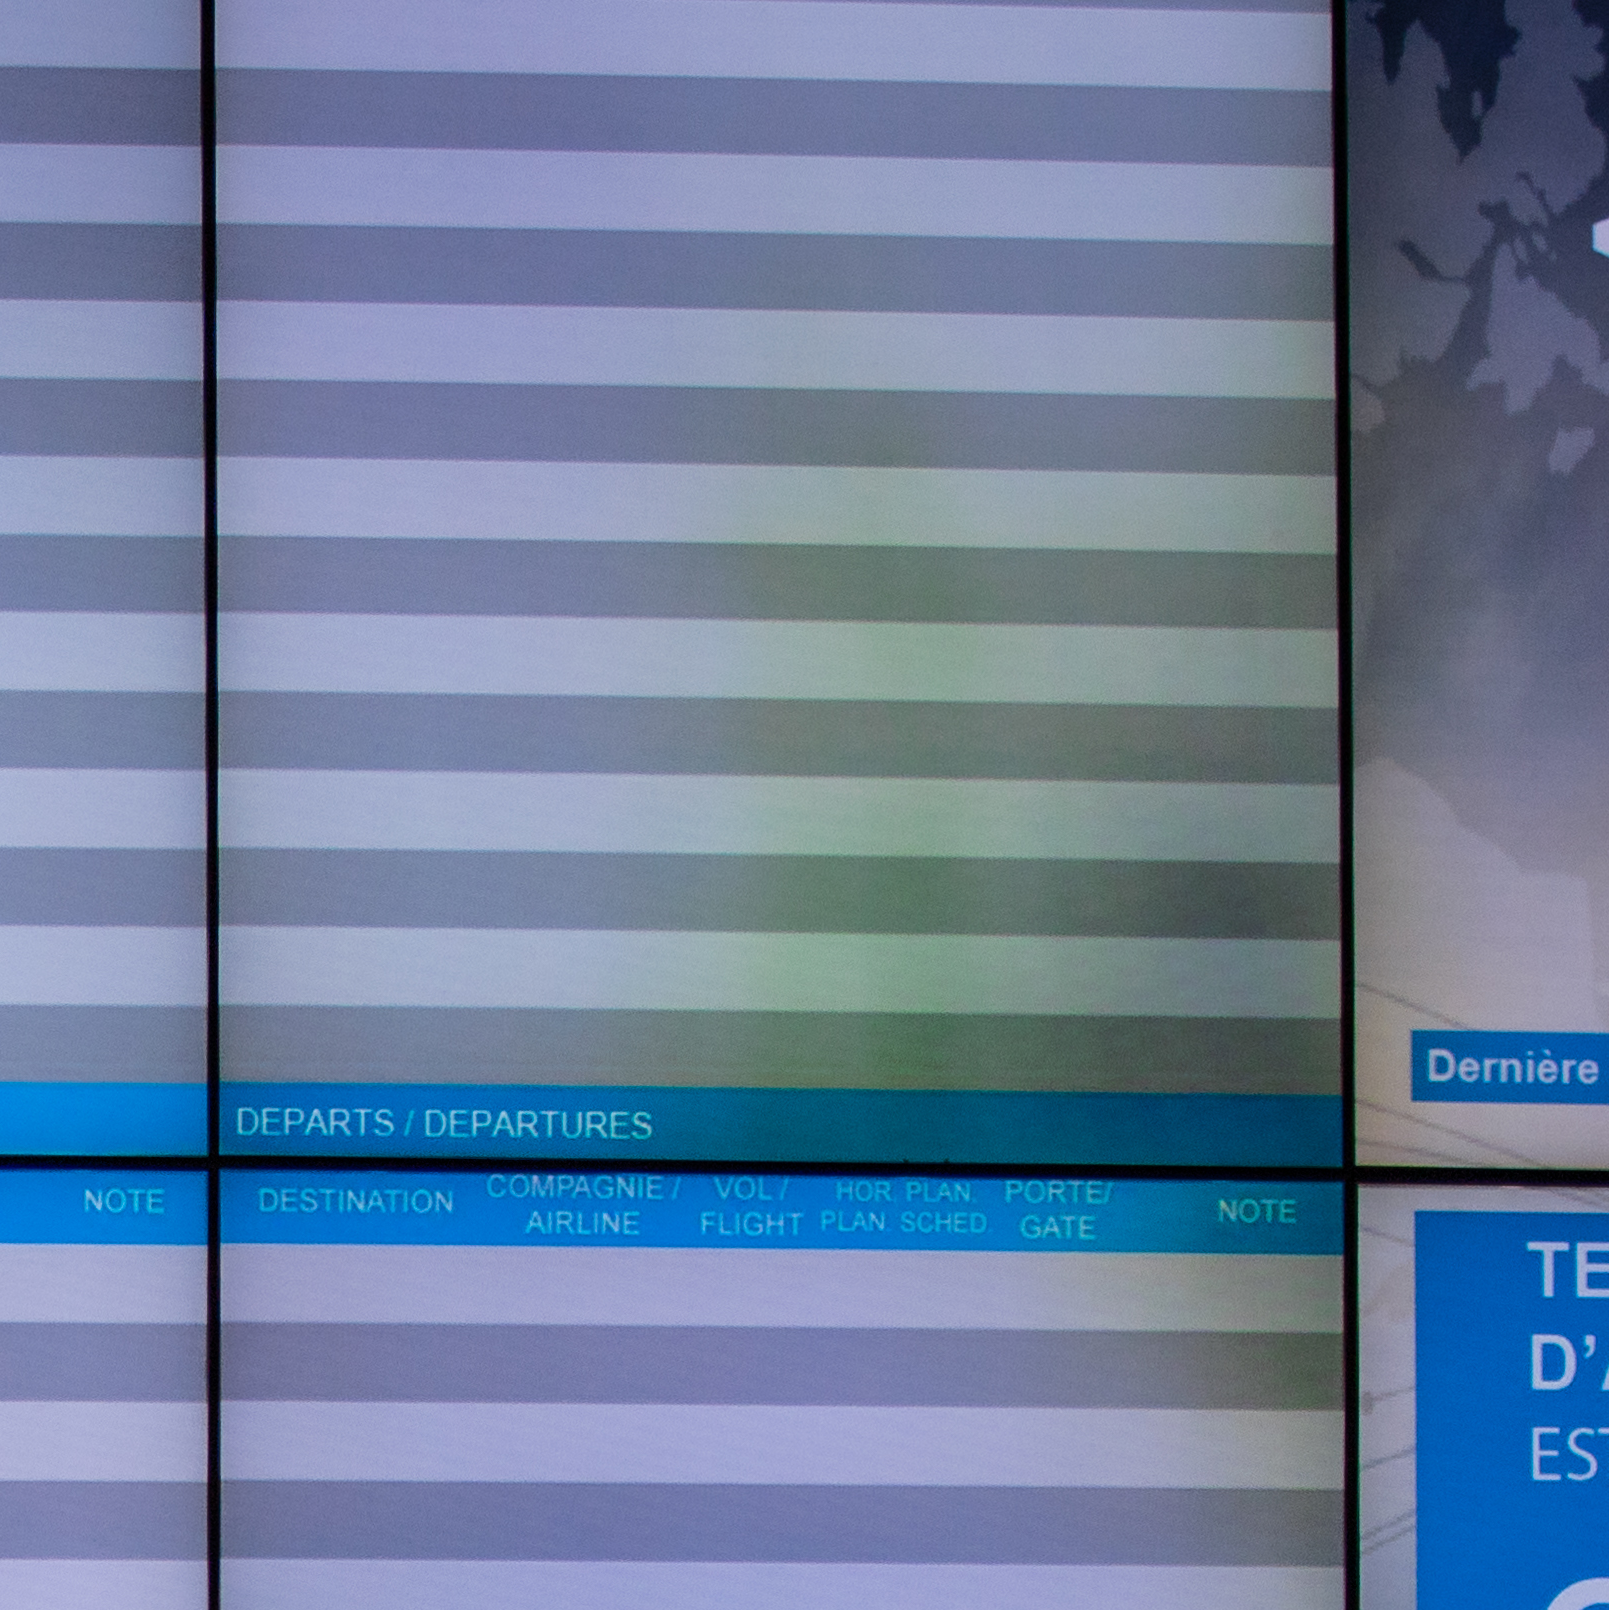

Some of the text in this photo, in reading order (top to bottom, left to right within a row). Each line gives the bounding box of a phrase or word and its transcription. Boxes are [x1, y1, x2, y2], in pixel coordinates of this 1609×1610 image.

[1427, 1049, 1598, 1084] Dernière
[236, 1107, 395, 1136] DEPARTS
[425, 1110, 653, 1140] DEPARTURES
[258, 1188, 453, 1213] DESTINATION
[487, 1174, 663, 1201] COMPAGNIE
[525, 1210, 640, 1235] AIRLINE
[700, 1211, 803, 1236] FLIGHT
[1217, 1198, 1295, 1223] NOTE
[1020, 1214, 1096, 1241] GATE
